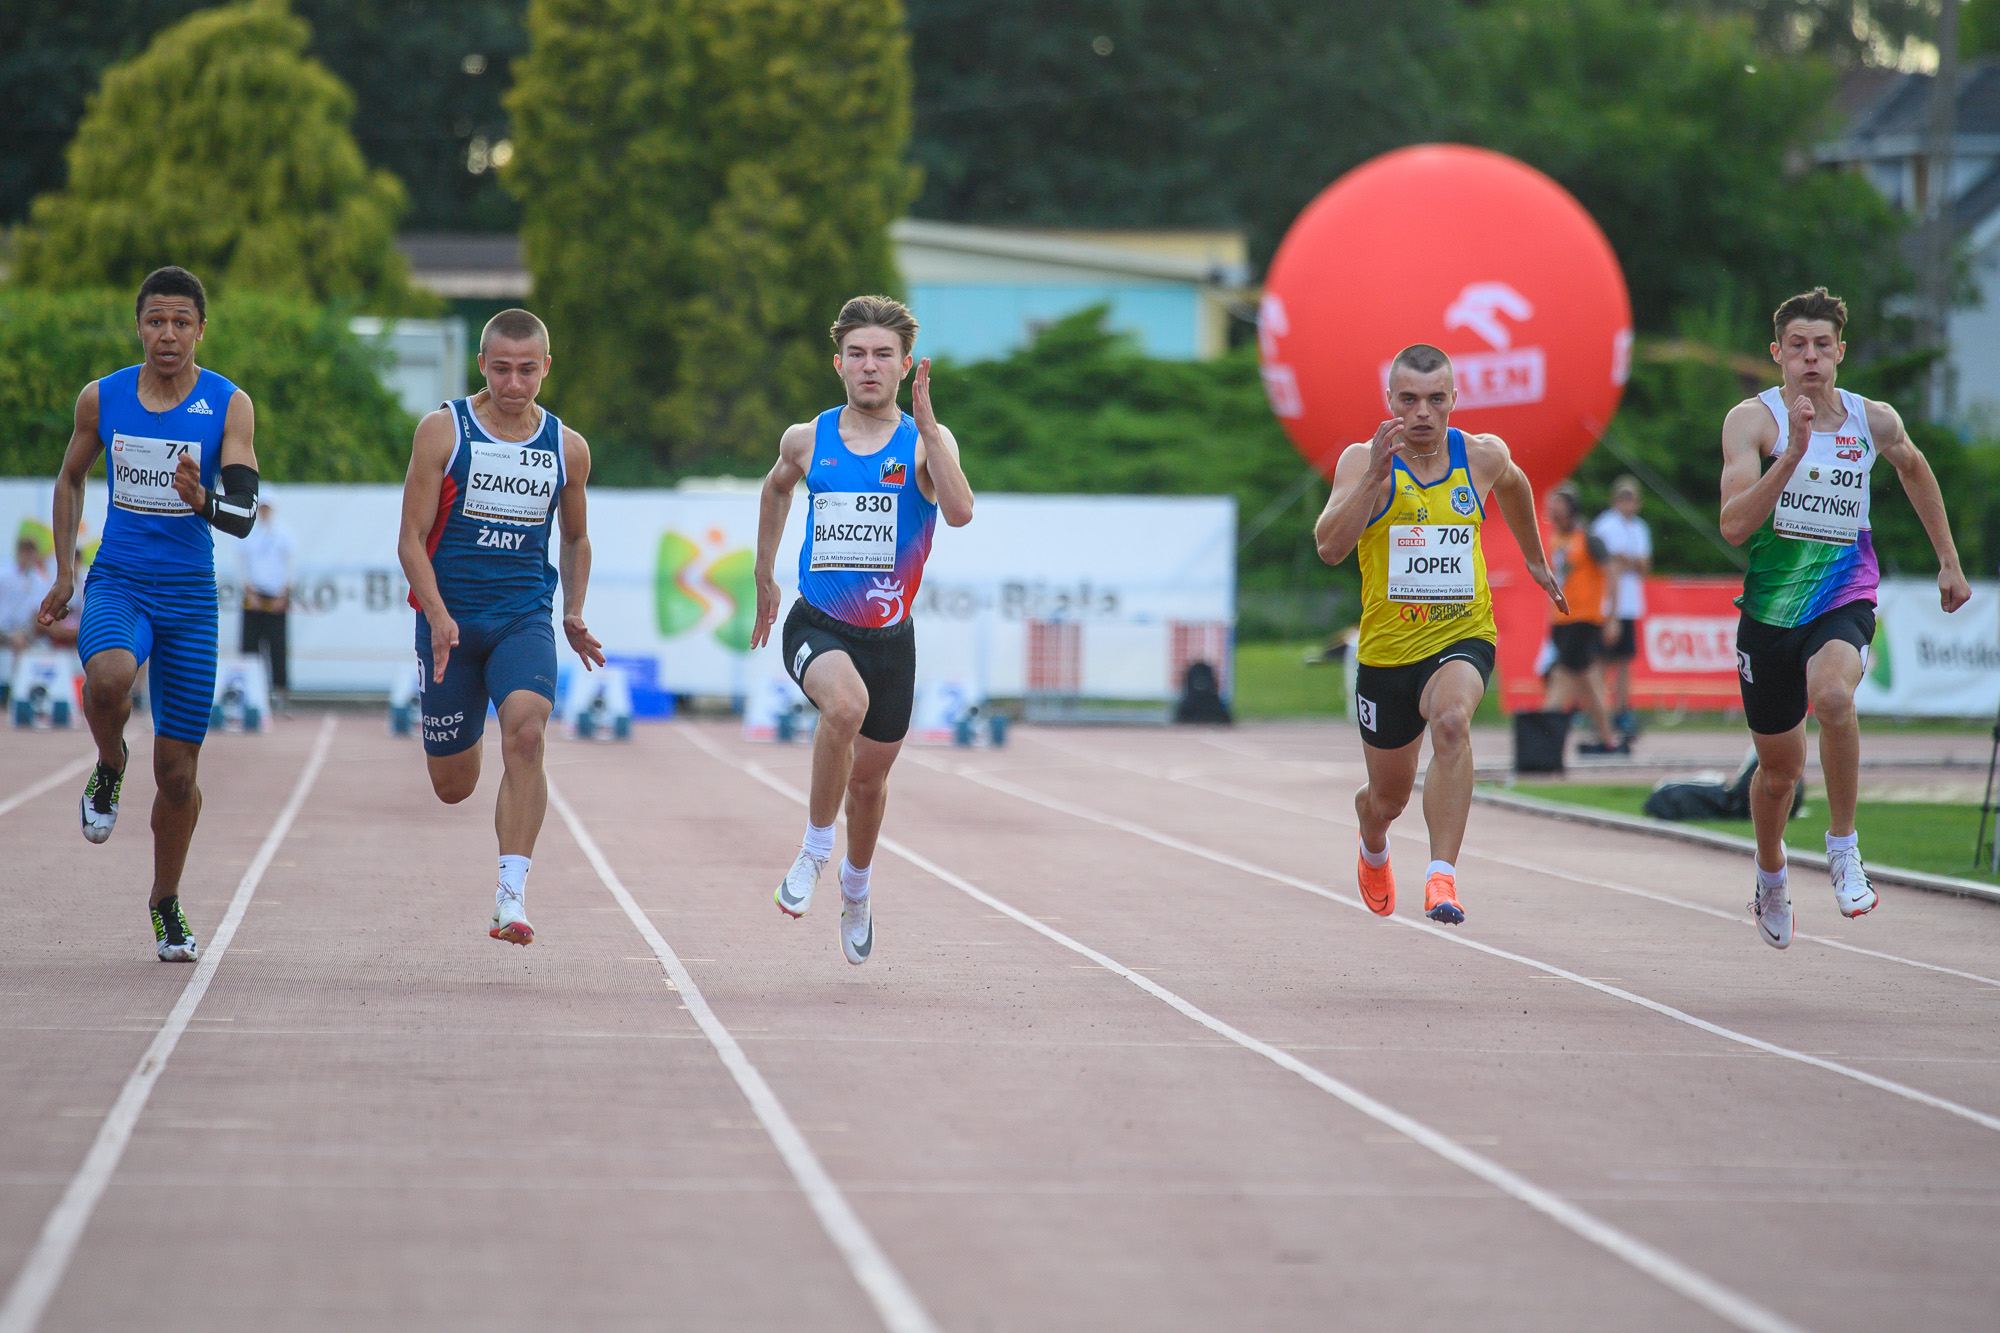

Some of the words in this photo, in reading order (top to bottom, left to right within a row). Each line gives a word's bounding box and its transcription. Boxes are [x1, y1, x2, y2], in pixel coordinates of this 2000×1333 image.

[187, 407, 213, 415] adidas
[1836, 436, 1857, 445] MKS
[520, 449, 553, 469] 198
[116, 464, 176, 487] KPORHOT
[1830, 469, 1863, 489] 301
[471, 473, 550, 498] SZAKOŁA
[133, 497, 166, 507] Mistrzostwa
[491, 506, 522, 515] Mistrzostwa
[855, 495, 893, 513] 830
[1780, 491, 1860, 518] BUCZYŃSKI
[815, 524, 894, 542] BŁASZCZYK
[1437, 528, 1470, 545] 706
[1785, 522, 1799, 530] PZLA
[1800, 525, 1832, 535] Mistrzostwa
[476, 526, 526, 550] ŻARY
[1405, 557, 1462, 574] JOPEK
[423, 711, 464, 728] GROS
[1361, 699, 1372, 726] 3
[424, 727, 459, 742] ŻARY
